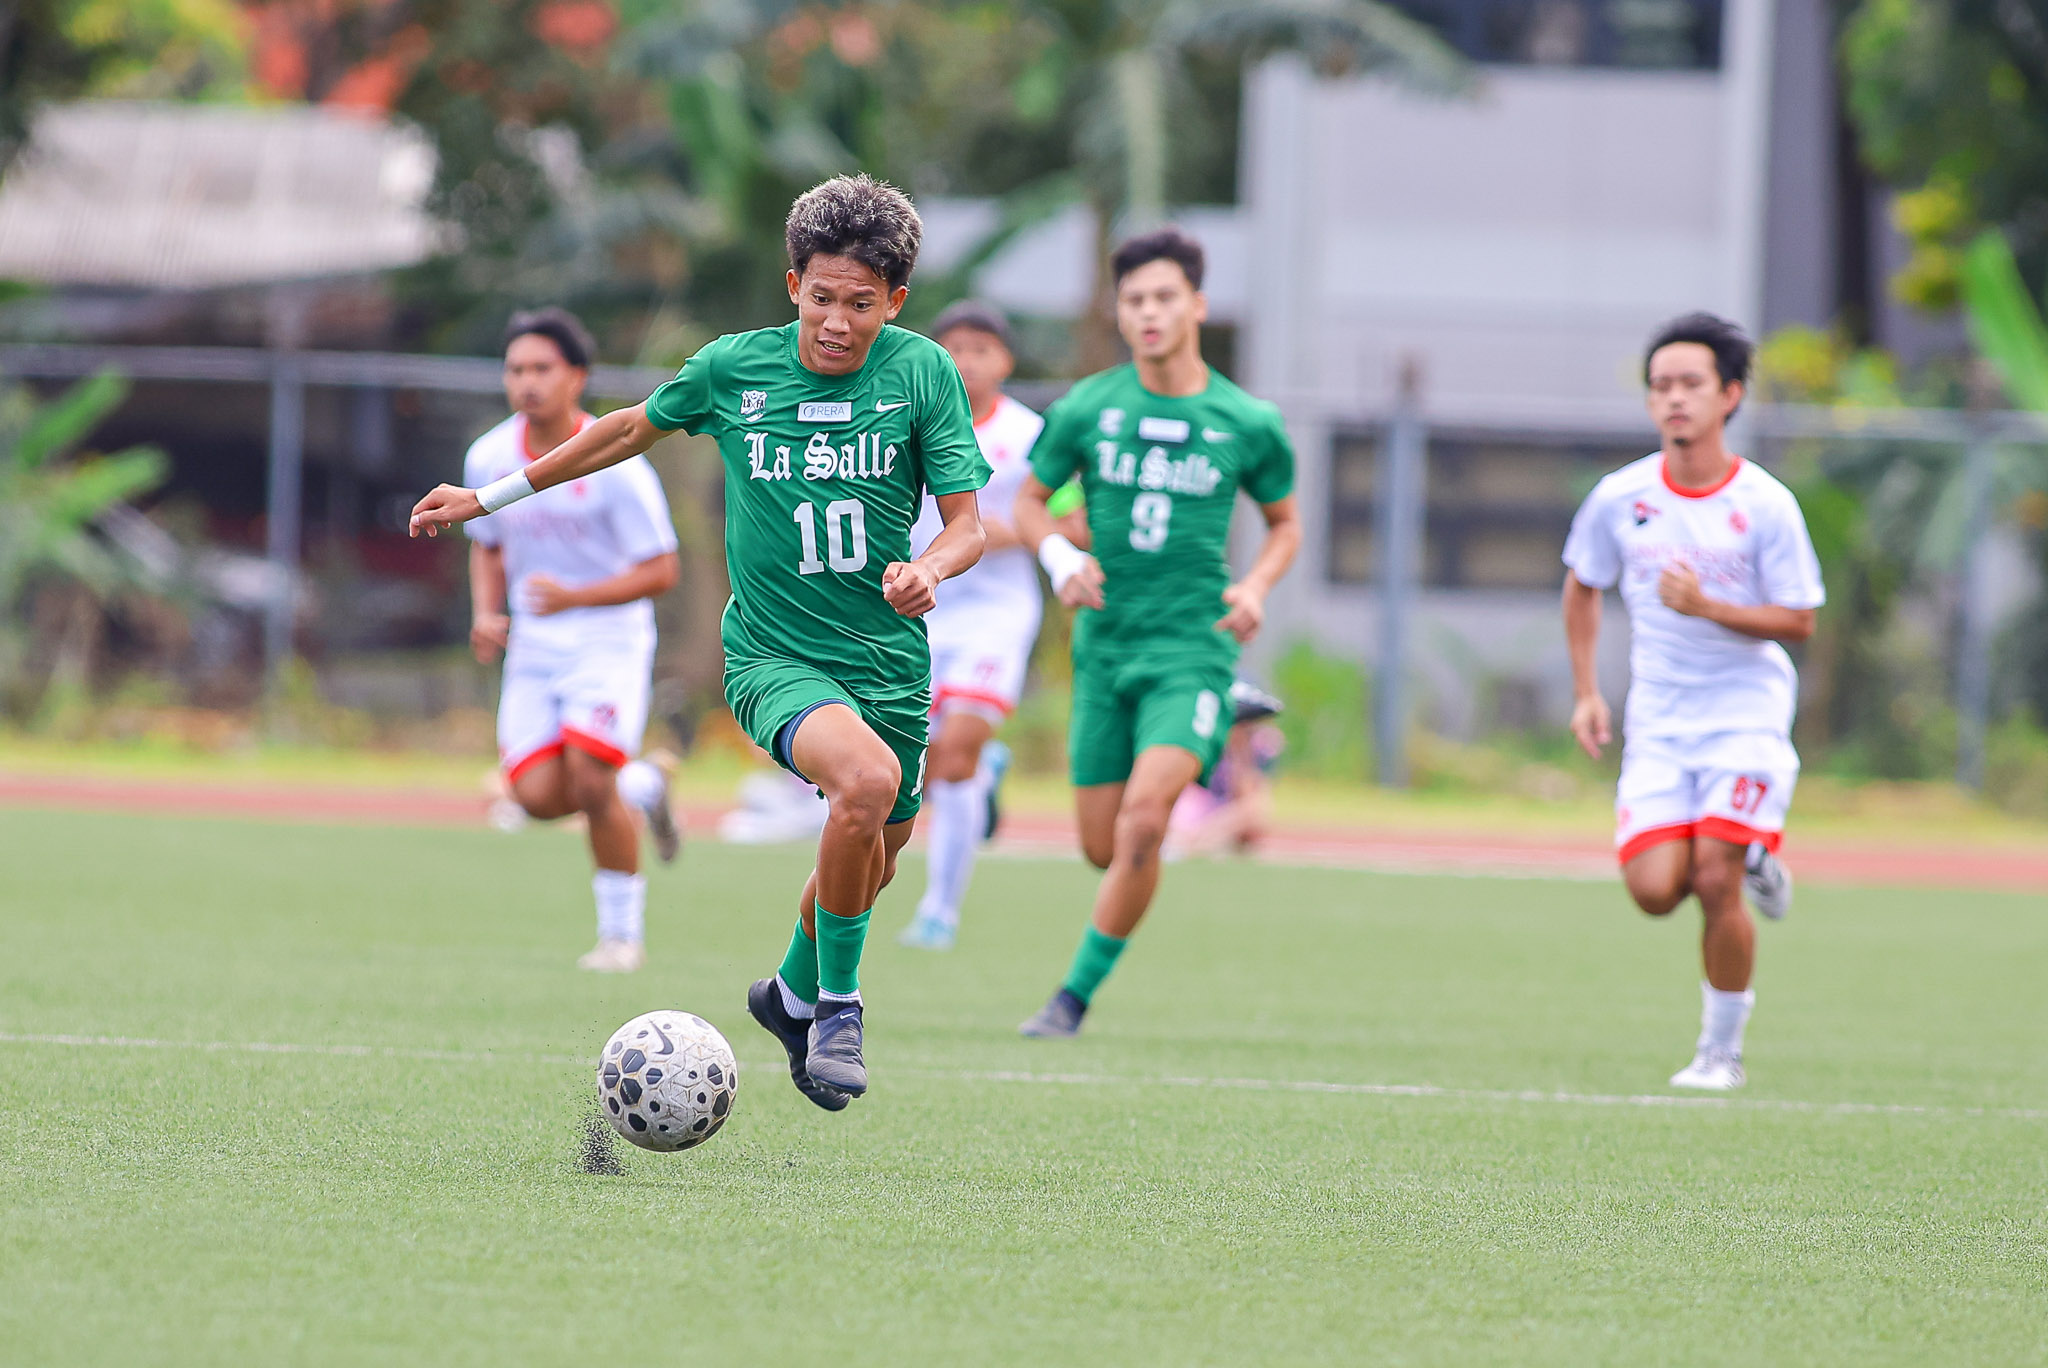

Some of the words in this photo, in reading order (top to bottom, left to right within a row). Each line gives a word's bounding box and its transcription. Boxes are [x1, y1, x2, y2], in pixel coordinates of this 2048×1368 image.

[816, 405, 845, 416] RERA
[744, 432, 793, 482] La
[802, 431, 898, 482] Salle
[1095, 440, 1138, 486] La
[1138, 445, 1223, 498] Salle
[793, 498, 868, 576] 10
[1129, 491, 1173, 554] 9
[911, 747, 928, 797] 1
